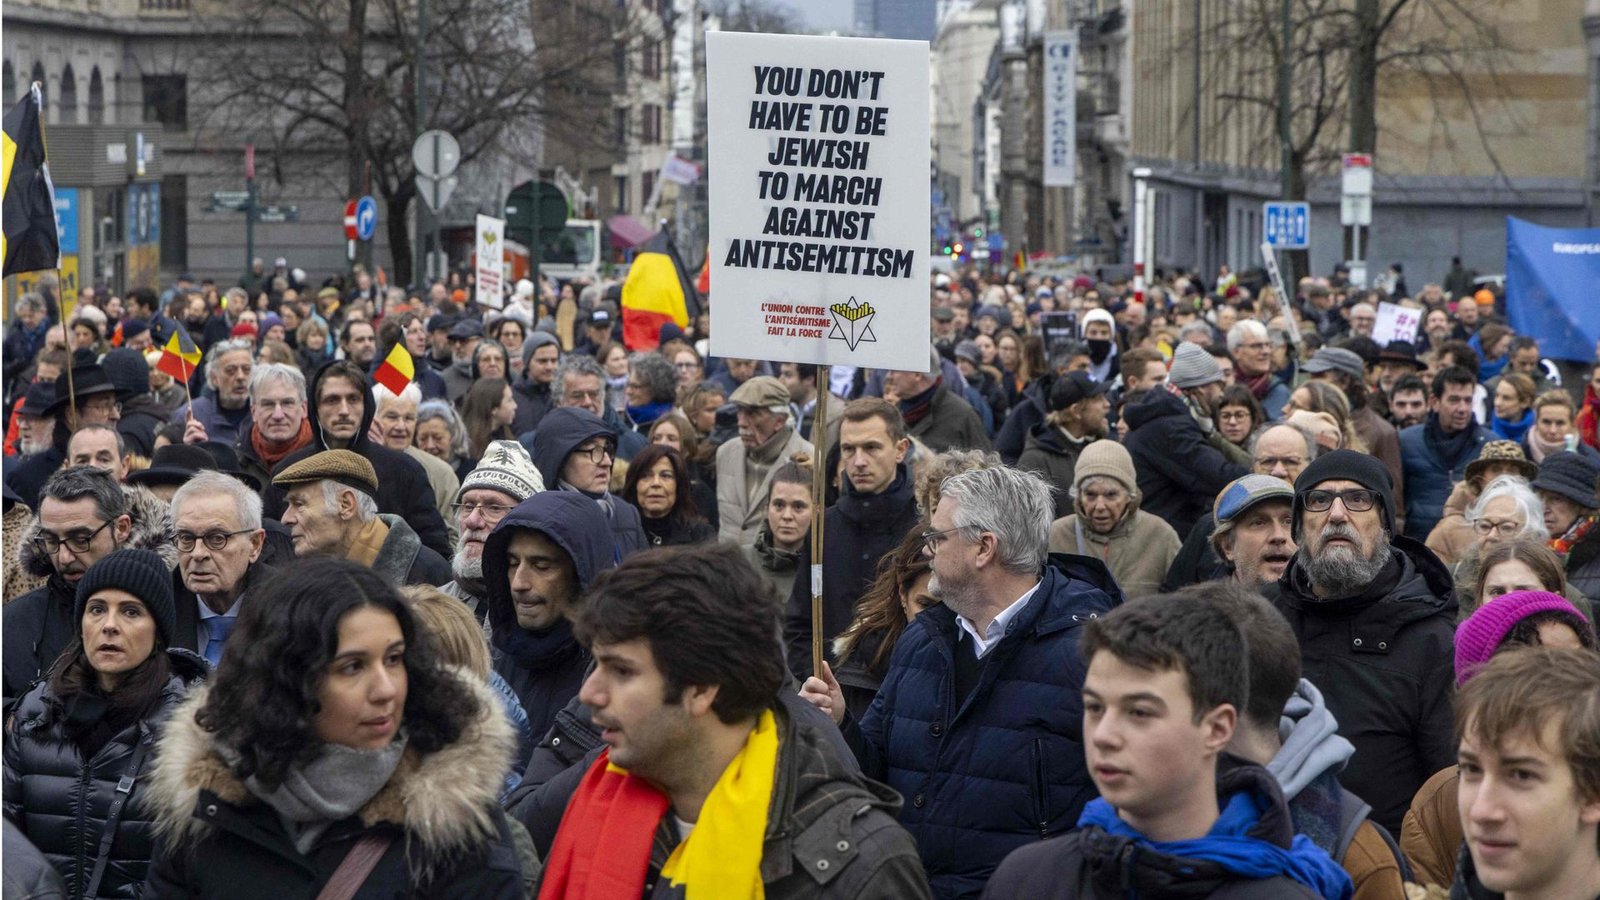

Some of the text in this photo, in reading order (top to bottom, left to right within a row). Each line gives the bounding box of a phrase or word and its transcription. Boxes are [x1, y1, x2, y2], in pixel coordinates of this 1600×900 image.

[754, 66, 885, 101] YOU DON'T
[748, 101, 889, 137] HAVE TO BE
[768, 137, 871, 171] JEWISH
[758, 171, 883, 207] TO MARCH
[762, 207, 876, 241] AGAINST
[723, 239, 915, 279] ANTISEMITISM
[760, 303, 825, 316] L'UNION CONTRE
[764, 314, 831, 328] L'ANTISÉMITISME
[767, 327, 823, 338] FAIT LA FORCE
